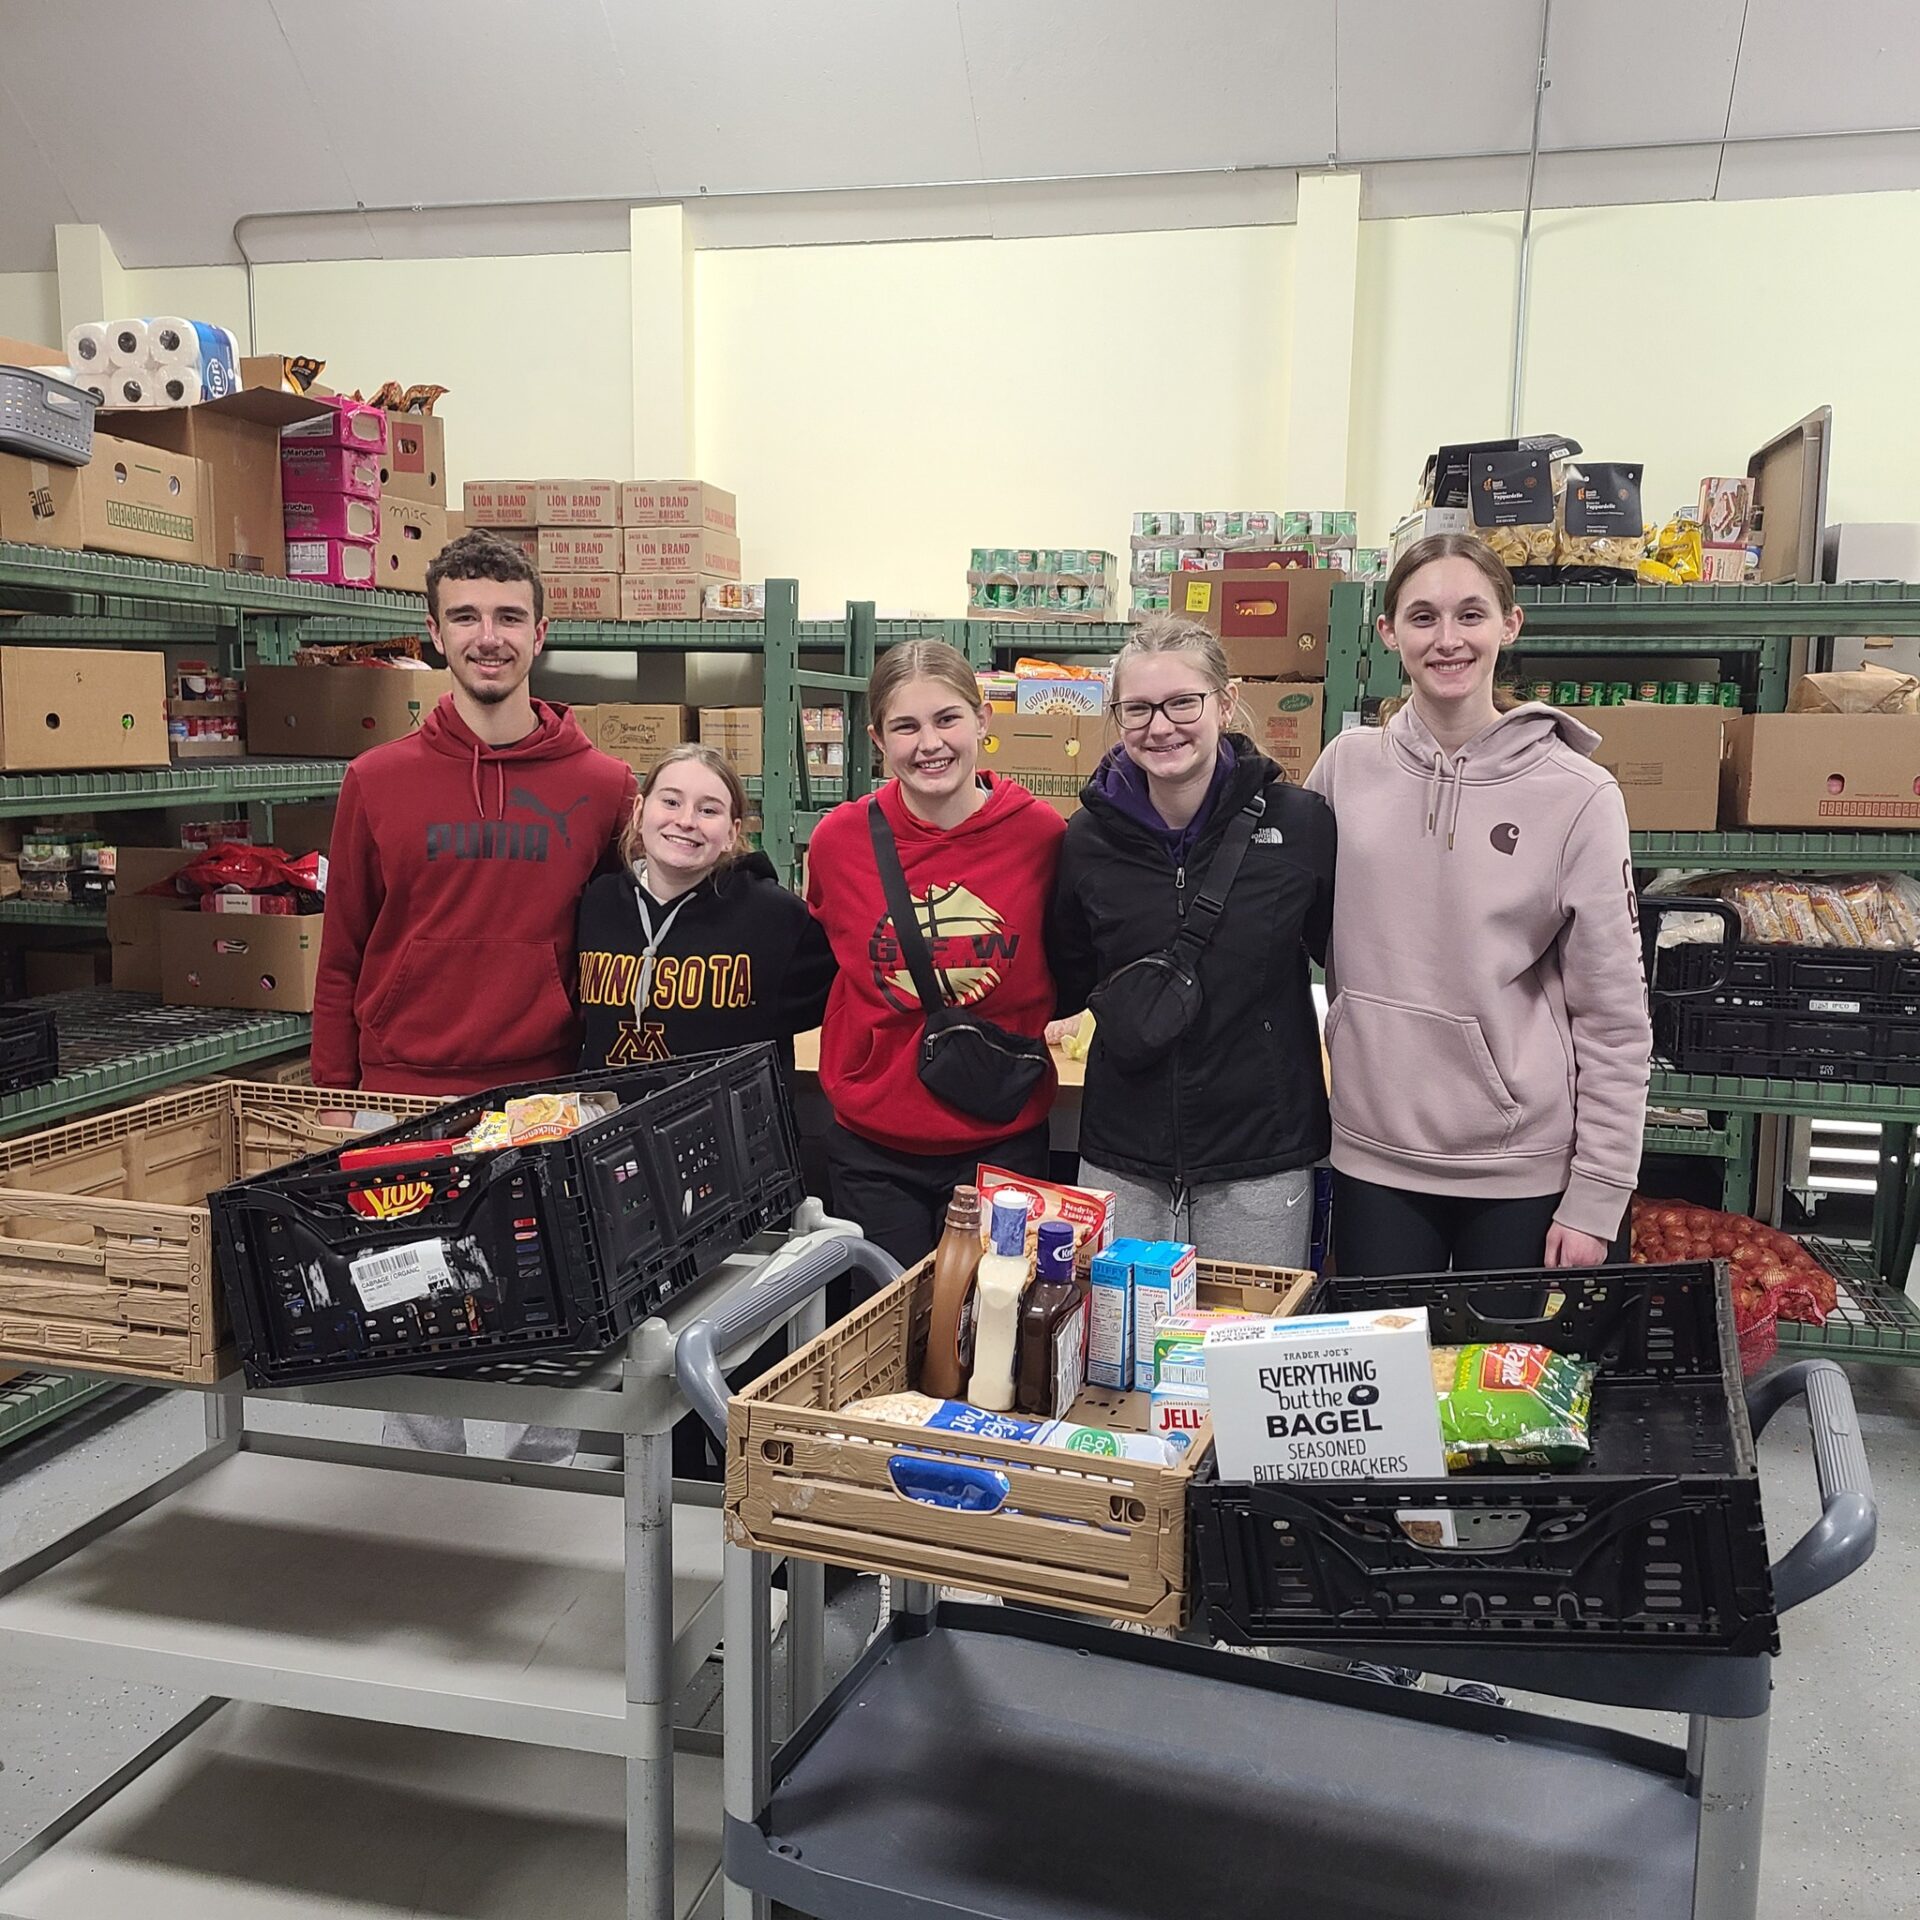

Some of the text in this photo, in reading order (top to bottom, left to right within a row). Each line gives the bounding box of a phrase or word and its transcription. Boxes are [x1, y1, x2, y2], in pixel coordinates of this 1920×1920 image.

[287, 449, 325, 458] Maruchan
[473, 495, 526, 507] LION BRAND
[547, 496, 601, 507] LION BRAND
[634, 497, 689, 508] LION BRAND
[497, 509, 522, 518] RAISINS
[571, 510, 597, 518] RAISINS
[659, 511, 685, 519] RAISINS
[550, 542, 603, 554] LION BRAND
[636, 543, 690, 554] LION BRAND
[574, 557, 599, 565] RAISINS
[660, 557, 686, 566] RAISINS
[548, 587, 601, 599] LION BRAND
[632, 589, 686, 600] LION BRAND
[571, 601, 597, 610] RAISINS
[657, 603, 682, 611] RAISINS
[1025, 686, 1094, 711] GOOD MORNING!
[426, 822, 549, 863] PUMA
[869, 939, 897, 962] G
[972, 934, 1020, 959] W
[578, 951, 752, 1010] INNESOTA
[606, 1020, 673, 1067] M
[528, 1125, 563, 1138] Chicken
[1061, 1247, 1074, 1259] Kra
[393, 1266, 421, 1280] ORGANIC
[1094, 1262, 1125, 1276] JIFFY
[427, 1273, 438, 1282] Sep
[1284, 1348, 1351, 1361] TRADER JOE'S
[1259, 1360, 1377, 1390] EVERYTHING
[1279, 1387, 1343, 1410] but the
[1159, 1407, 1204, 1431] JELL-
[1266, 1408, 1383, 1439] BAGEL
[1288, 1438, 1367, 1460] SEASONED
[1253, 1455, 1408, 1481] BITE SIZED CRACKERS
